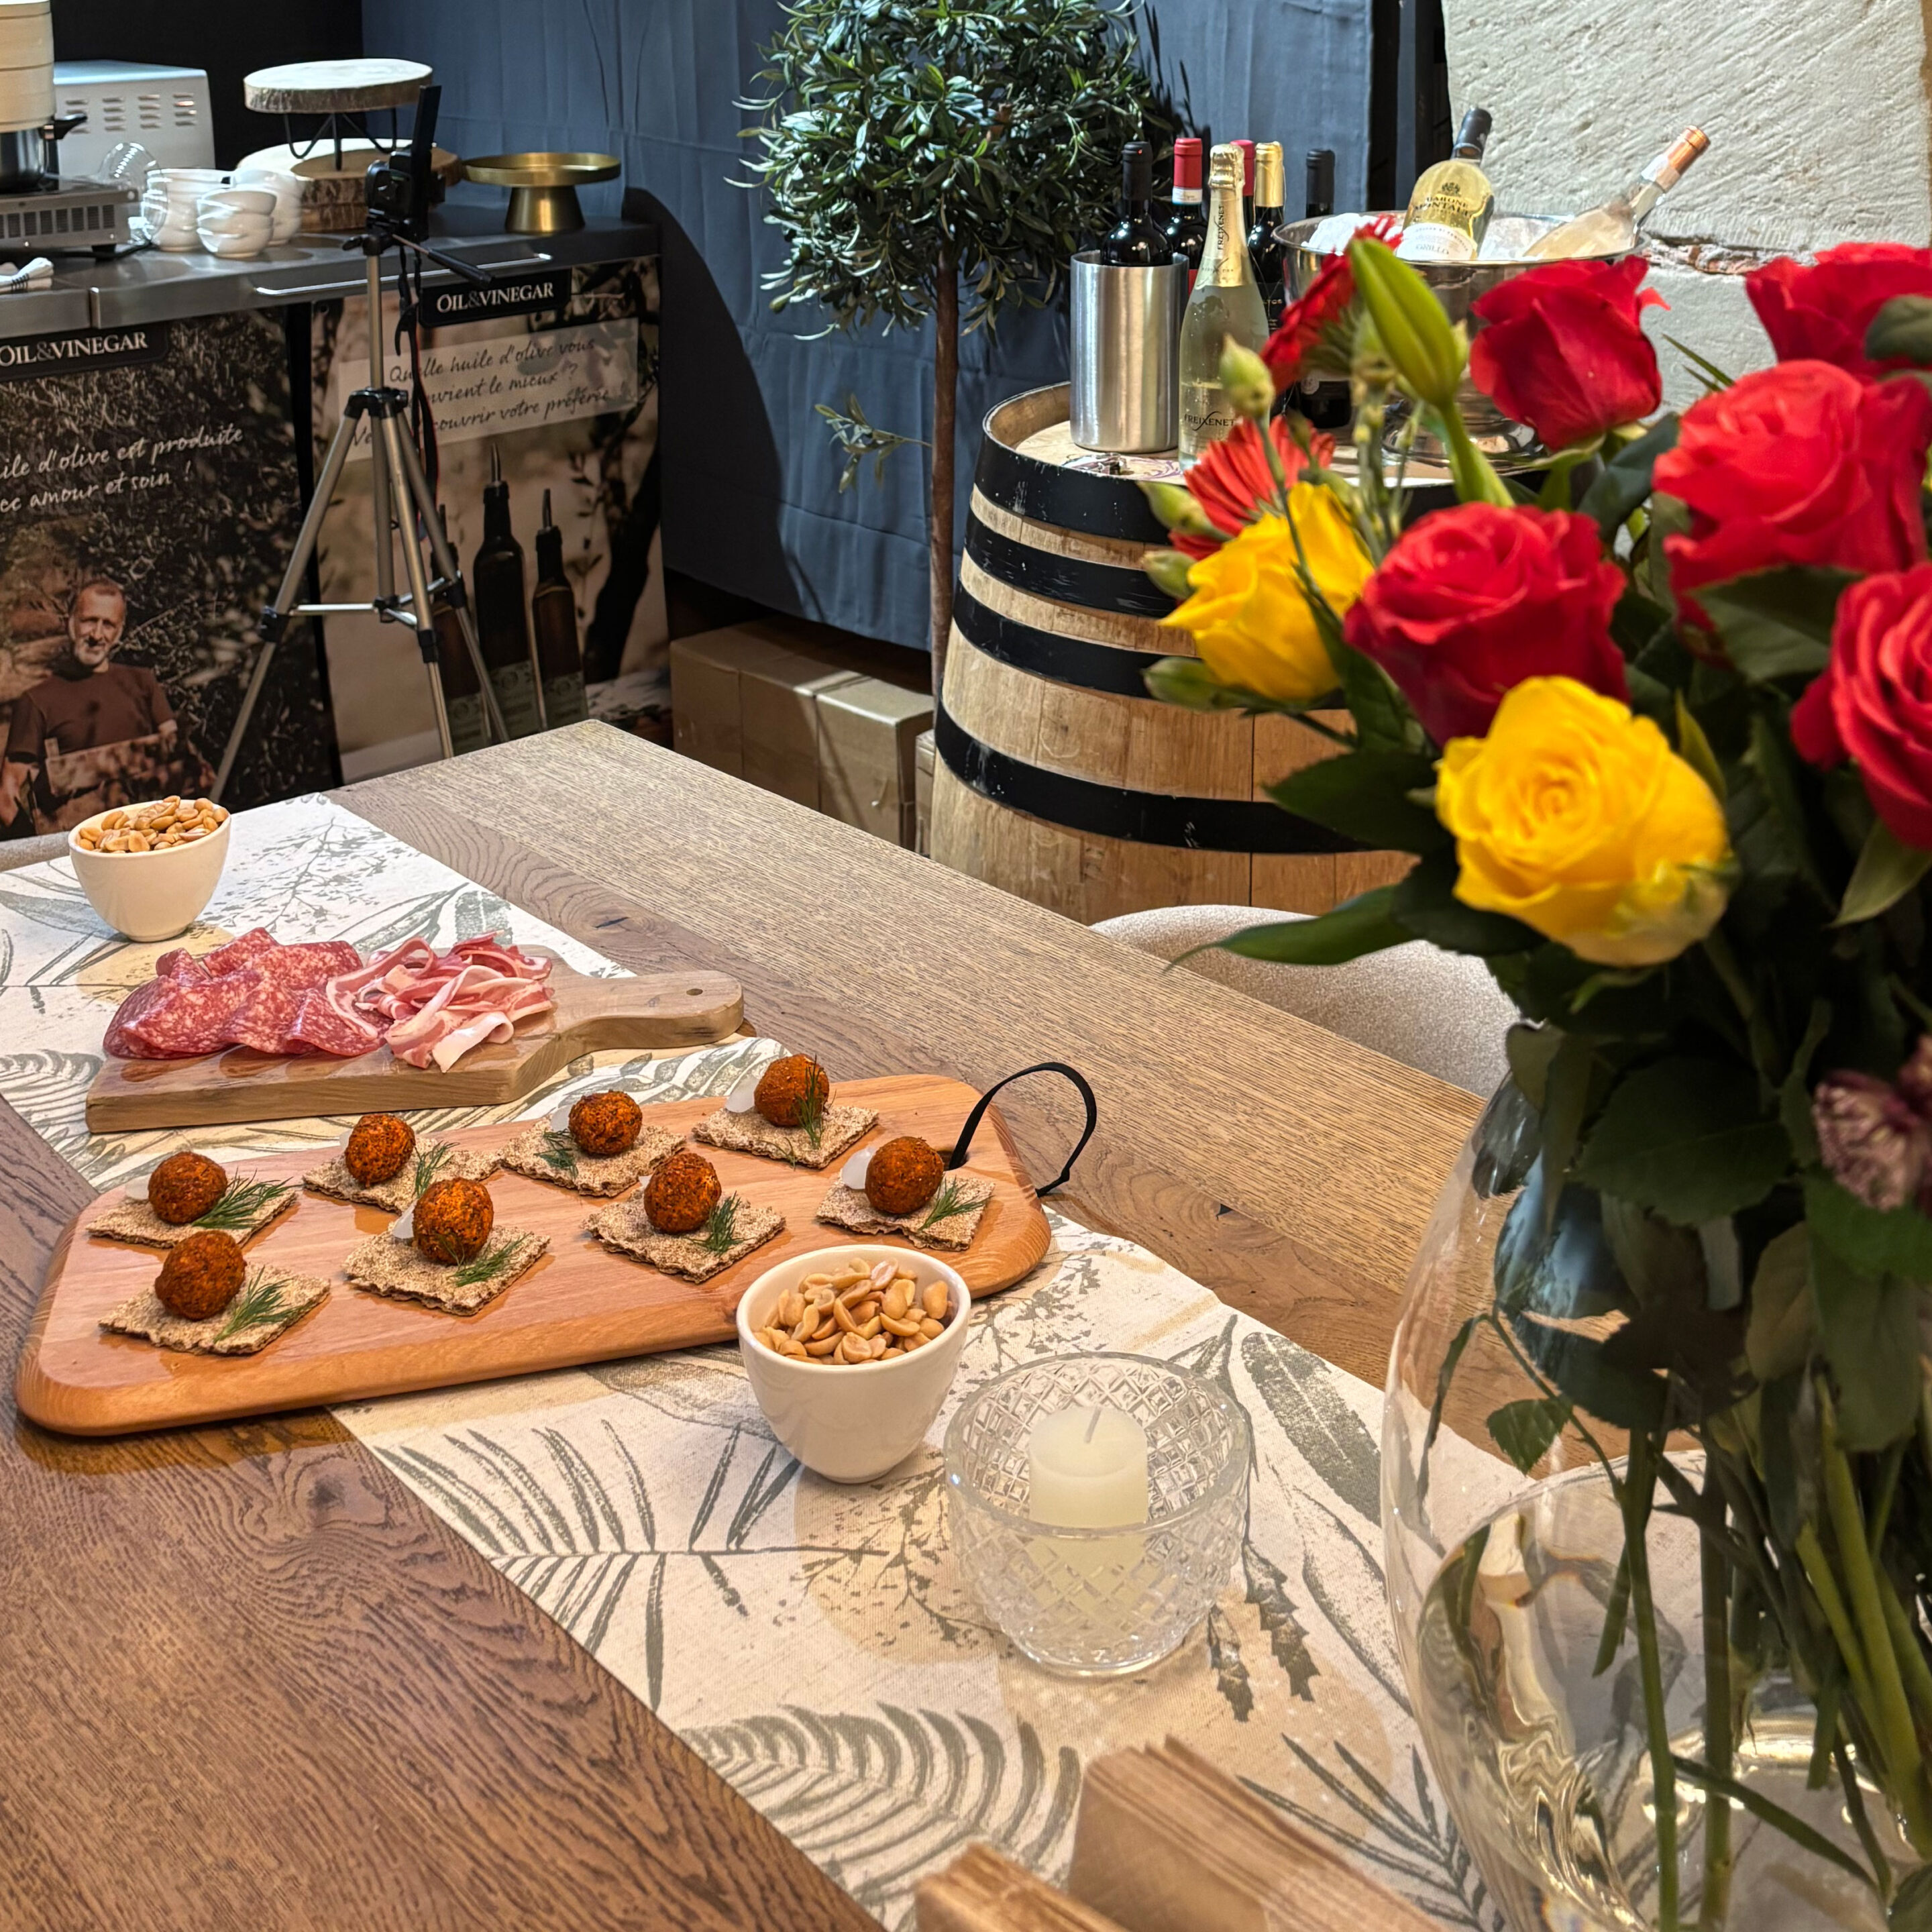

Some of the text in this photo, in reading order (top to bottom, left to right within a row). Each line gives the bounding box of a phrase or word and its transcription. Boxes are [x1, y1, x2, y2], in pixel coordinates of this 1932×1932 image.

[437, 282, 555, 313] OIL&VINEGAR
[0, 331, 148, 367] OIL&VINEGAR
[390, 338, 596, 382] Qulle huile d'olive vous
[427, 378, 487, 404] nvient
[489, 375, 502, 394] le
[509, 372, 558, 390] mieux
[500, 399, 539, 420] votre
[1184, 411, 1236, 431] FREIXENET
[0, 423, 244, 479] ile d'olive est produite
[0, 497, 22, 513] ec
[30, 484, 99, 508] amour
[105, 471, 129, 495] et
[129, 468, 173, 490] soin
